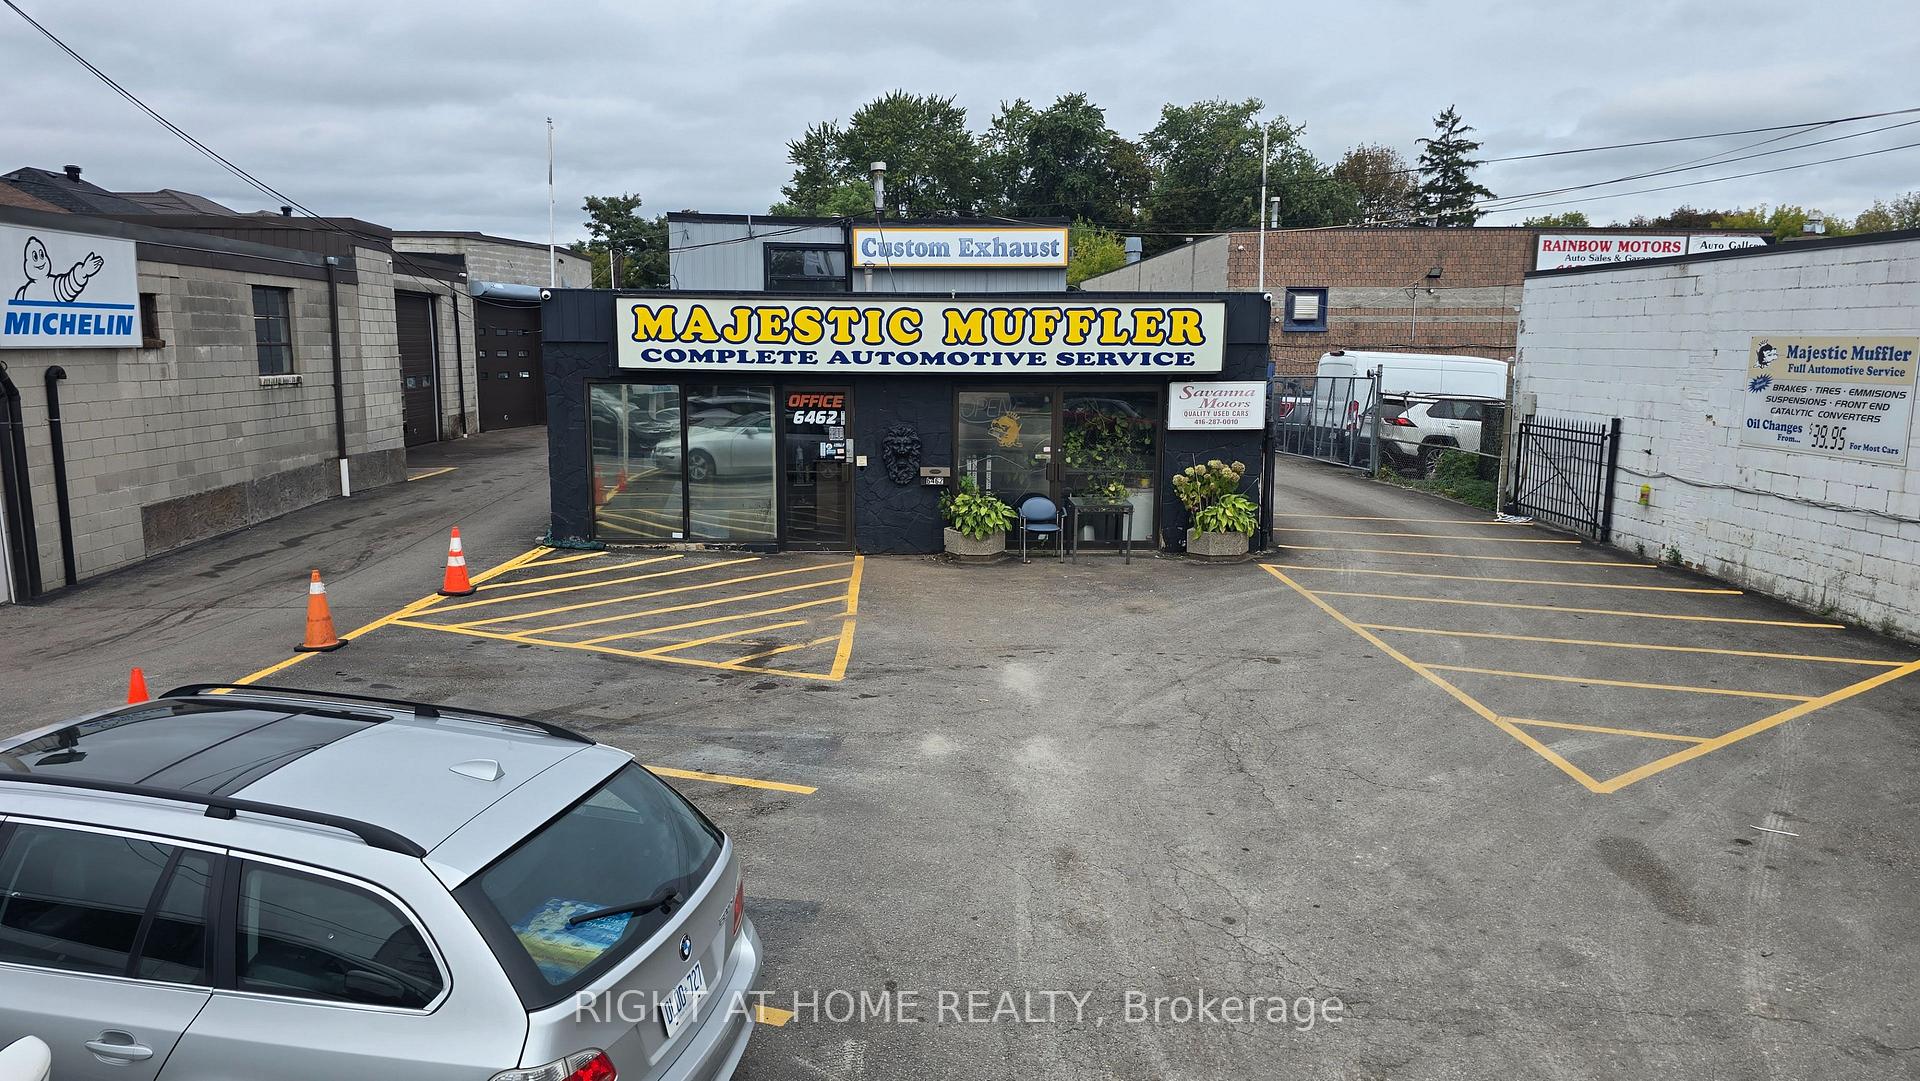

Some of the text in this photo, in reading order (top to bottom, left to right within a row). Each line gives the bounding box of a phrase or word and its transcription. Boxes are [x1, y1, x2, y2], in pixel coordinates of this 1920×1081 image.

[861, 237, 1060, 258] Custom Exhaust
[1542, 239, 1681, 253] RAINBOW MOTORS
[1564, 254, 1586, 262] Auto
[1588, 254, 1611, 262] Sales
[4, 311, 134, 336] MICHELIN
[630, 304, 1206, 346] MAJESTIC MUFFLER
[640, 348, 1196, 367] COMPLETE AUTOMOTIVE SERVICE
[1786, 344, 1912, 363] Majestic Muffler
[1787, 363, 1906, 377] Full Automotive Service
[1179, 385, 1256, 400] Savanna
[1772, 384, 1907, 399] BRAKES TIRES EMMISIONS
[788, 394, 844, 408] OFFICE
[1198, 398, 1251, 409] Motors
[1765, 395, 1890, 411] SUSPENSIONS FRONT END
[793, 410, 838, 424] 6462
[1770, 407, 1881, 423] CATALYTIC CONVERTERS
[1746, 417, 1803, 435] Oil Changes
[1777, 434, 1801, 443] From...
[1849, 442, 1899, 455] For Most Cars
